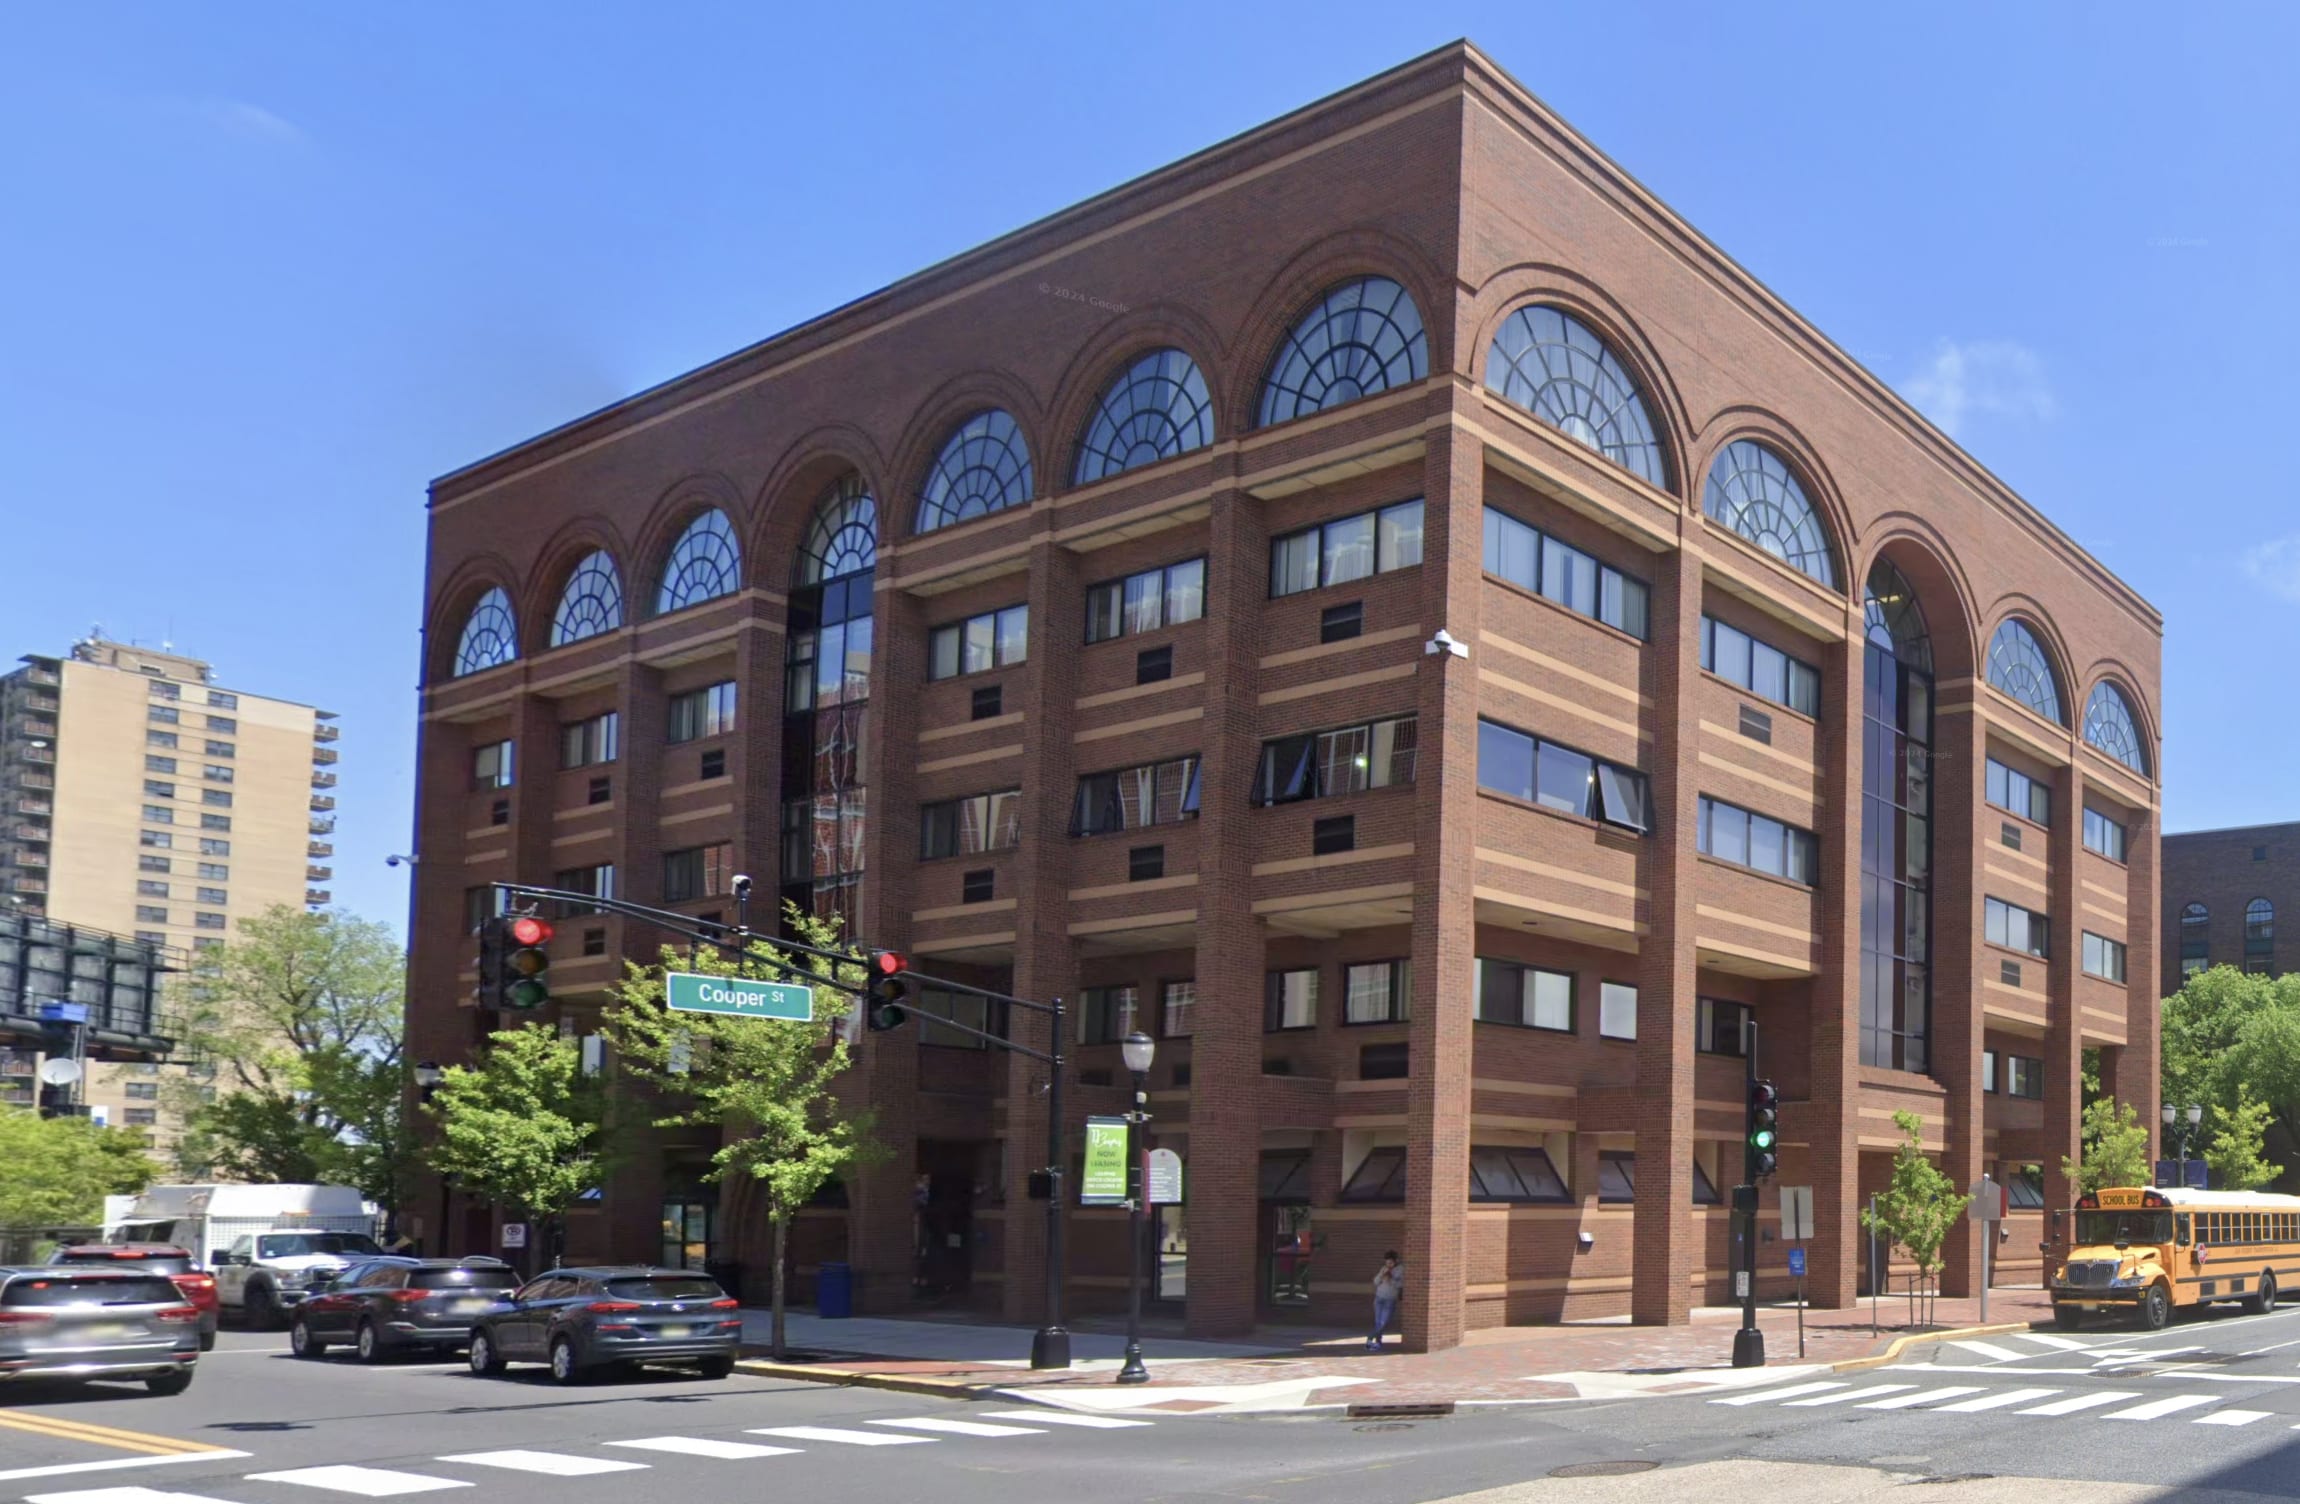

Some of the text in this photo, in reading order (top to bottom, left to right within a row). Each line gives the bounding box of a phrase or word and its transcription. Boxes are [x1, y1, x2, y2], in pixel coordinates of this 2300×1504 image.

[699, 984, 784, 1009] Cooper St
[2102, 1194, 2140, 1206] SCHOOL BUS
